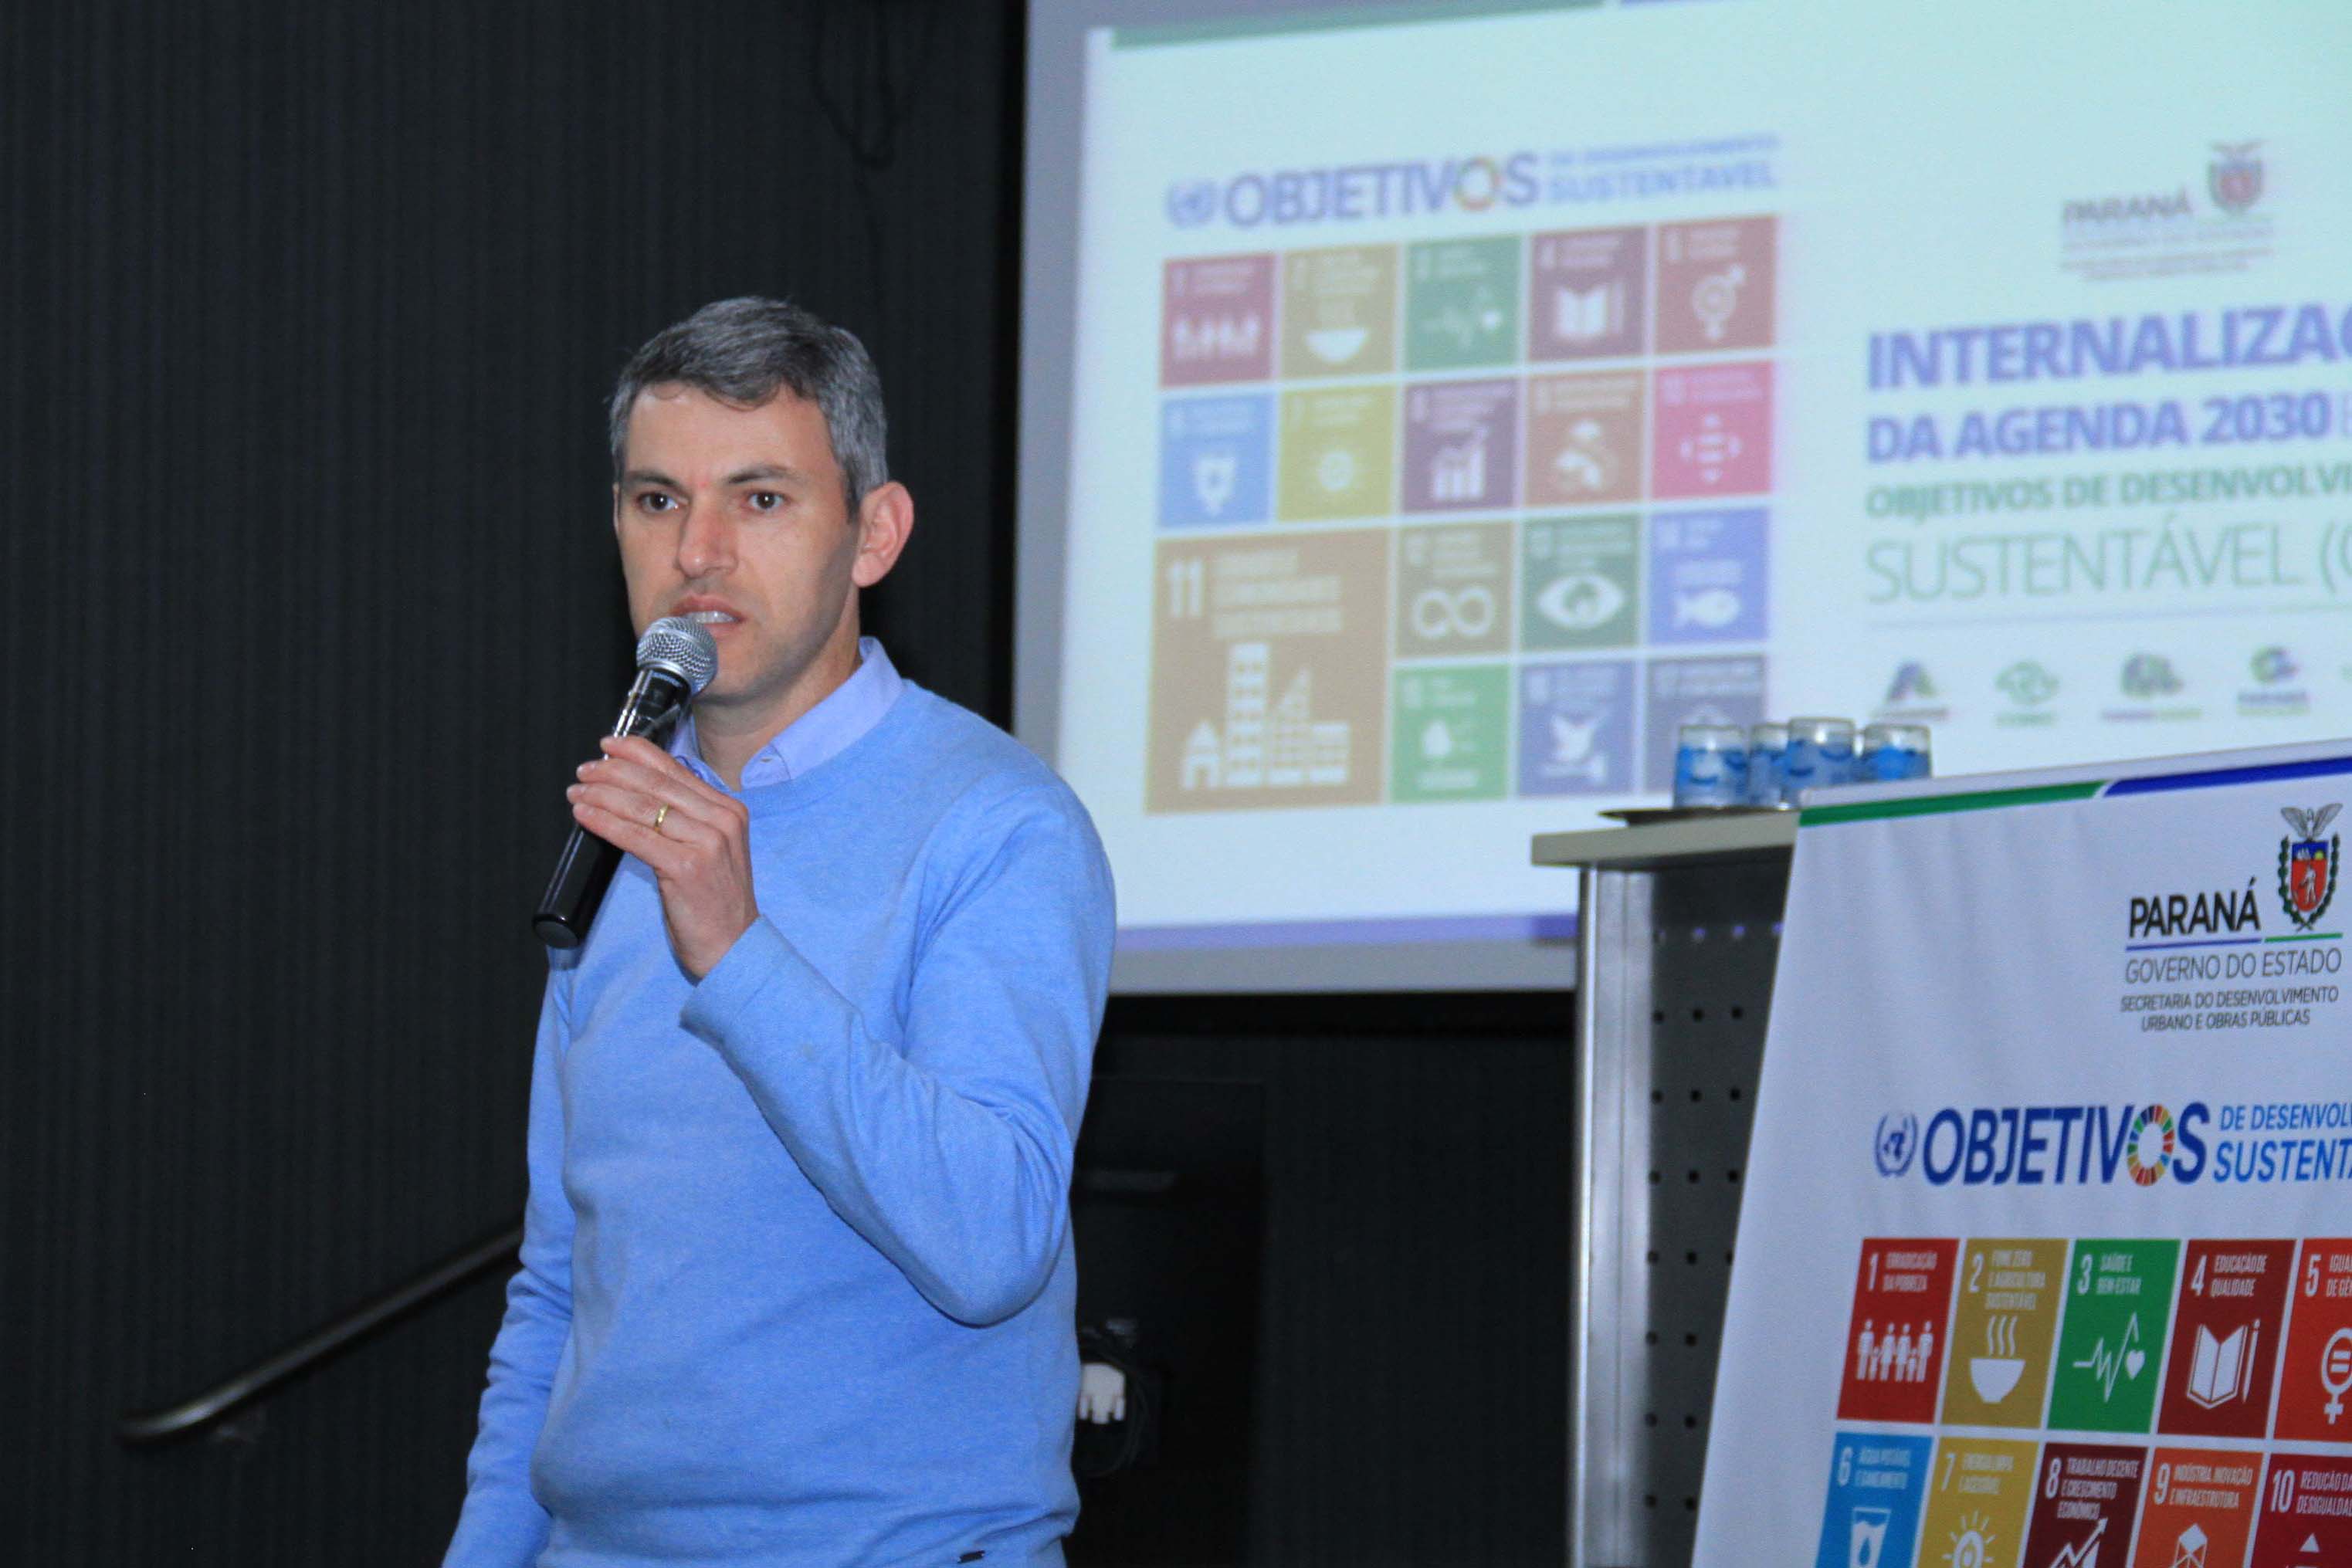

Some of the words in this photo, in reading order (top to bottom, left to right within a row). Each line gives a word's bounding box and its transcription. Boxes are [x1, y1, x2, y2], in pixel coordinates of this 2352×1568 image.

[1224, 154, 1540, 227] OBJETIVOS
[2063, 185, 2192, 225] PARANÁ
[1868, 302, 2352, 391] INTERNALIZA
[1868, 414, 1943, 465] DA
[1954, 398, 2188, 459] AGENDA
[2200, 390, 2332, 446] 2030
[1866, 477, 2054, 525] OBJETIVOS
[2064, 475, 2114, 509] DE
[1866, 513, 2300, 605] SUSTENTÁVEL
[2129, 875, 2262, 938] PARANÁ
[2125, 955, 2221, 984] GOVERNO
[2225, 953, 2257, 979] DO
[2262, 947, 2342, 977] ESTADO
[2120, 992, 2191, 1012] SECRETARIA
[2194, 991, 2214, 1009] DO
[2217, 985, 2340, 1008] DESENVOLVIMENTO
[2141, 1014, 2193, 1032] URBANO
[2195, 1013, 2203, 1029] E
[2206, 1011, 2248, 1030] OBRAS
[2250, 1008, 2310, 1028] PÚBLICAS
[2220, 1105, 2245, 1131] DE
[2251, 1101, 2352, 1130] DESENVOL
[1923, 1102, 2211, 1187] OBJETIVOS
[2213, 1137, 2352, 1183] SUSTENT
[1869, 1252, 1879, 1292] 1
[1970, 1252, 1984, 1293] 2
[2077, 1253, 2093, 1295] 3
[2191, 1254, 2207, 1297] 4
[2209, 1278, 2256, 1298] QUALIDADE
[2304, 1253, 2322, 1297] 5
[1837, 1445, 1852, 1487] 6
[1940, 1452, 1956, 1492] 7
[2045, 1458, 2061, 1499] 8
[2154, 1462, 2171, 1505] 9
[2300, 1469, 2341, 1491] REDUÇÃO
[2271, 1469, 2296, 1513] 10
